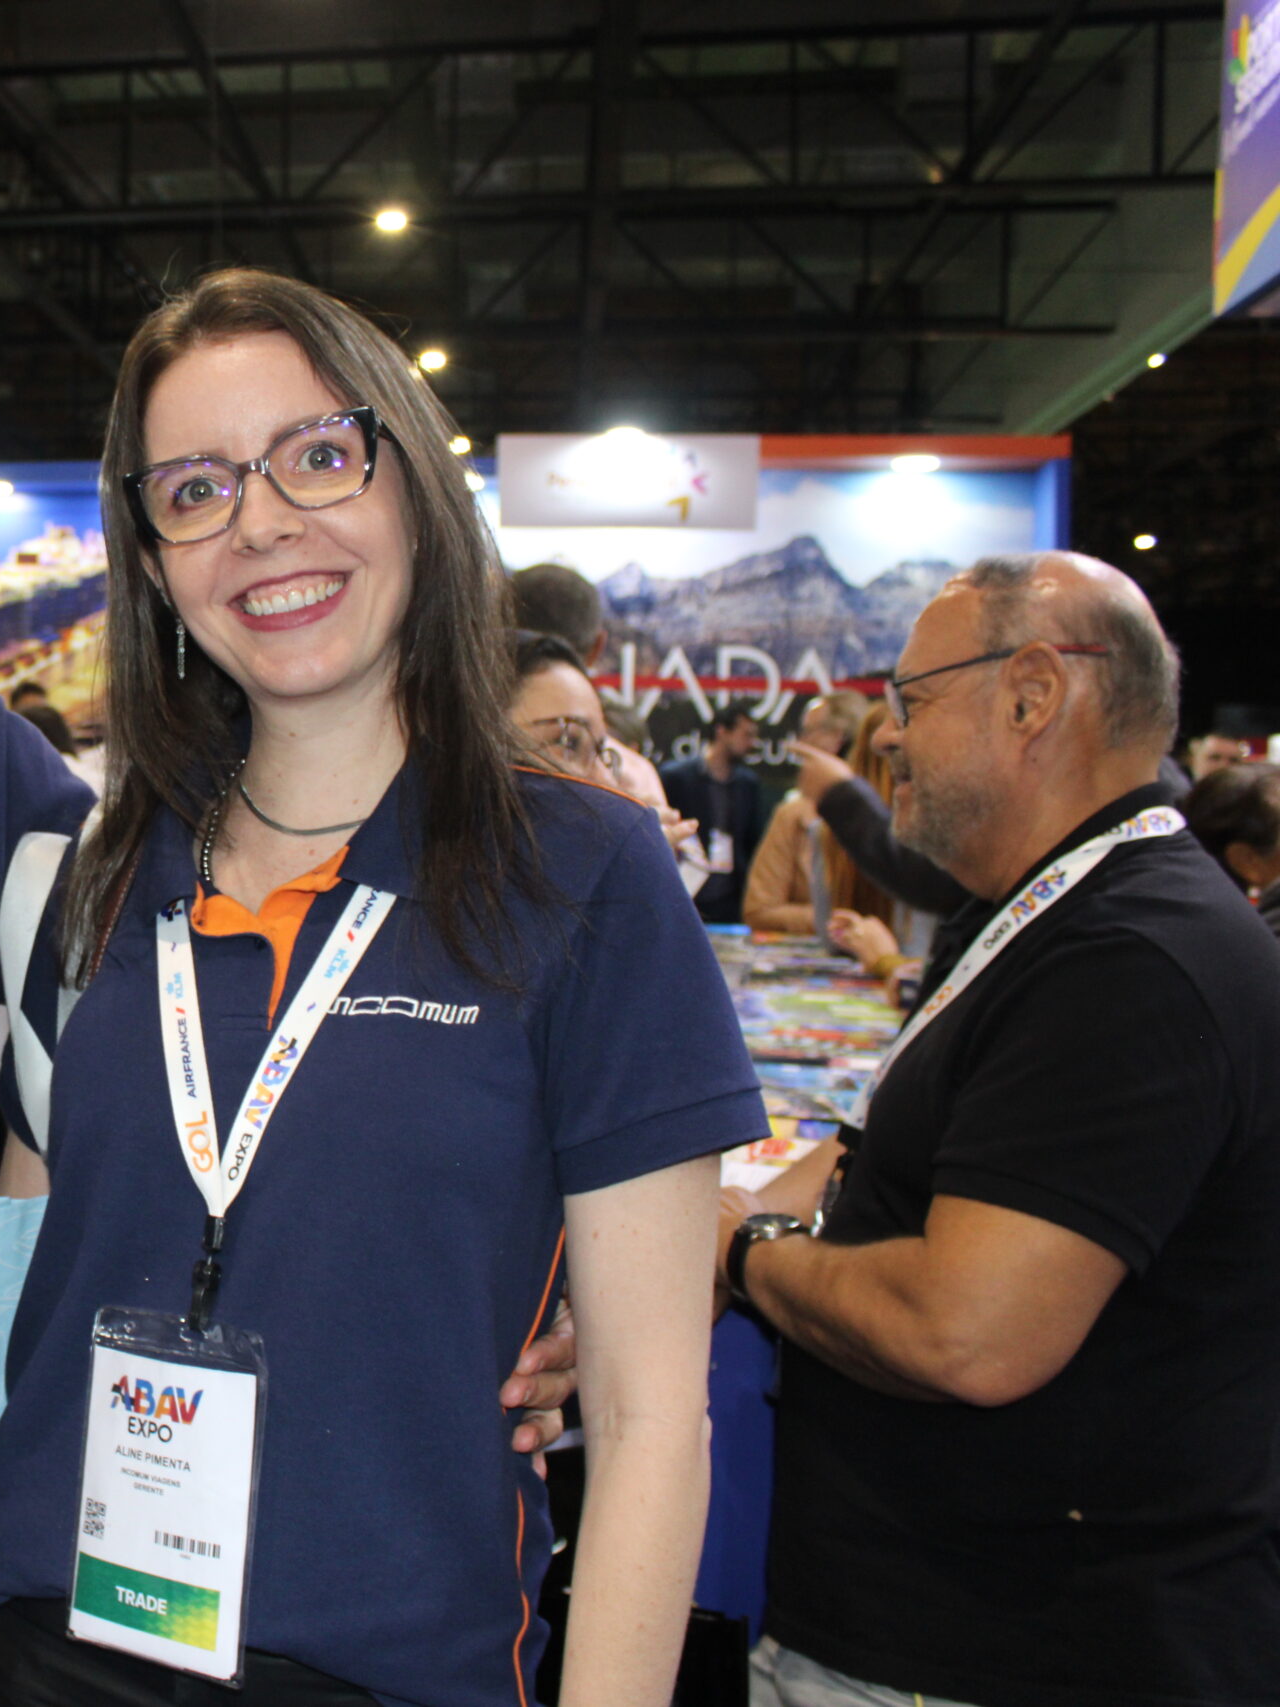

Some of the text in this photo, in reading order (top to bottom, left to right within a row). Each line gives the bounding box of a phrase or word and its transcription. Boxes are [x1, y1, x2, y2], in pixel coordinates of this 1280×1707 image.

[179, 1017, 197, 1099] AIRFRANCE
[228, 1034, 299, 1182] ABAV EXPO
[185, 1110, 215, 1174] GOL
[110, 1374, 203, 1425] ABAV
[128, 1416, 173, 1443] EXPO
[115, 1444, 192, 1472] ALINE PIMENTA
[115, 1585, 168, 1617] TRADE
